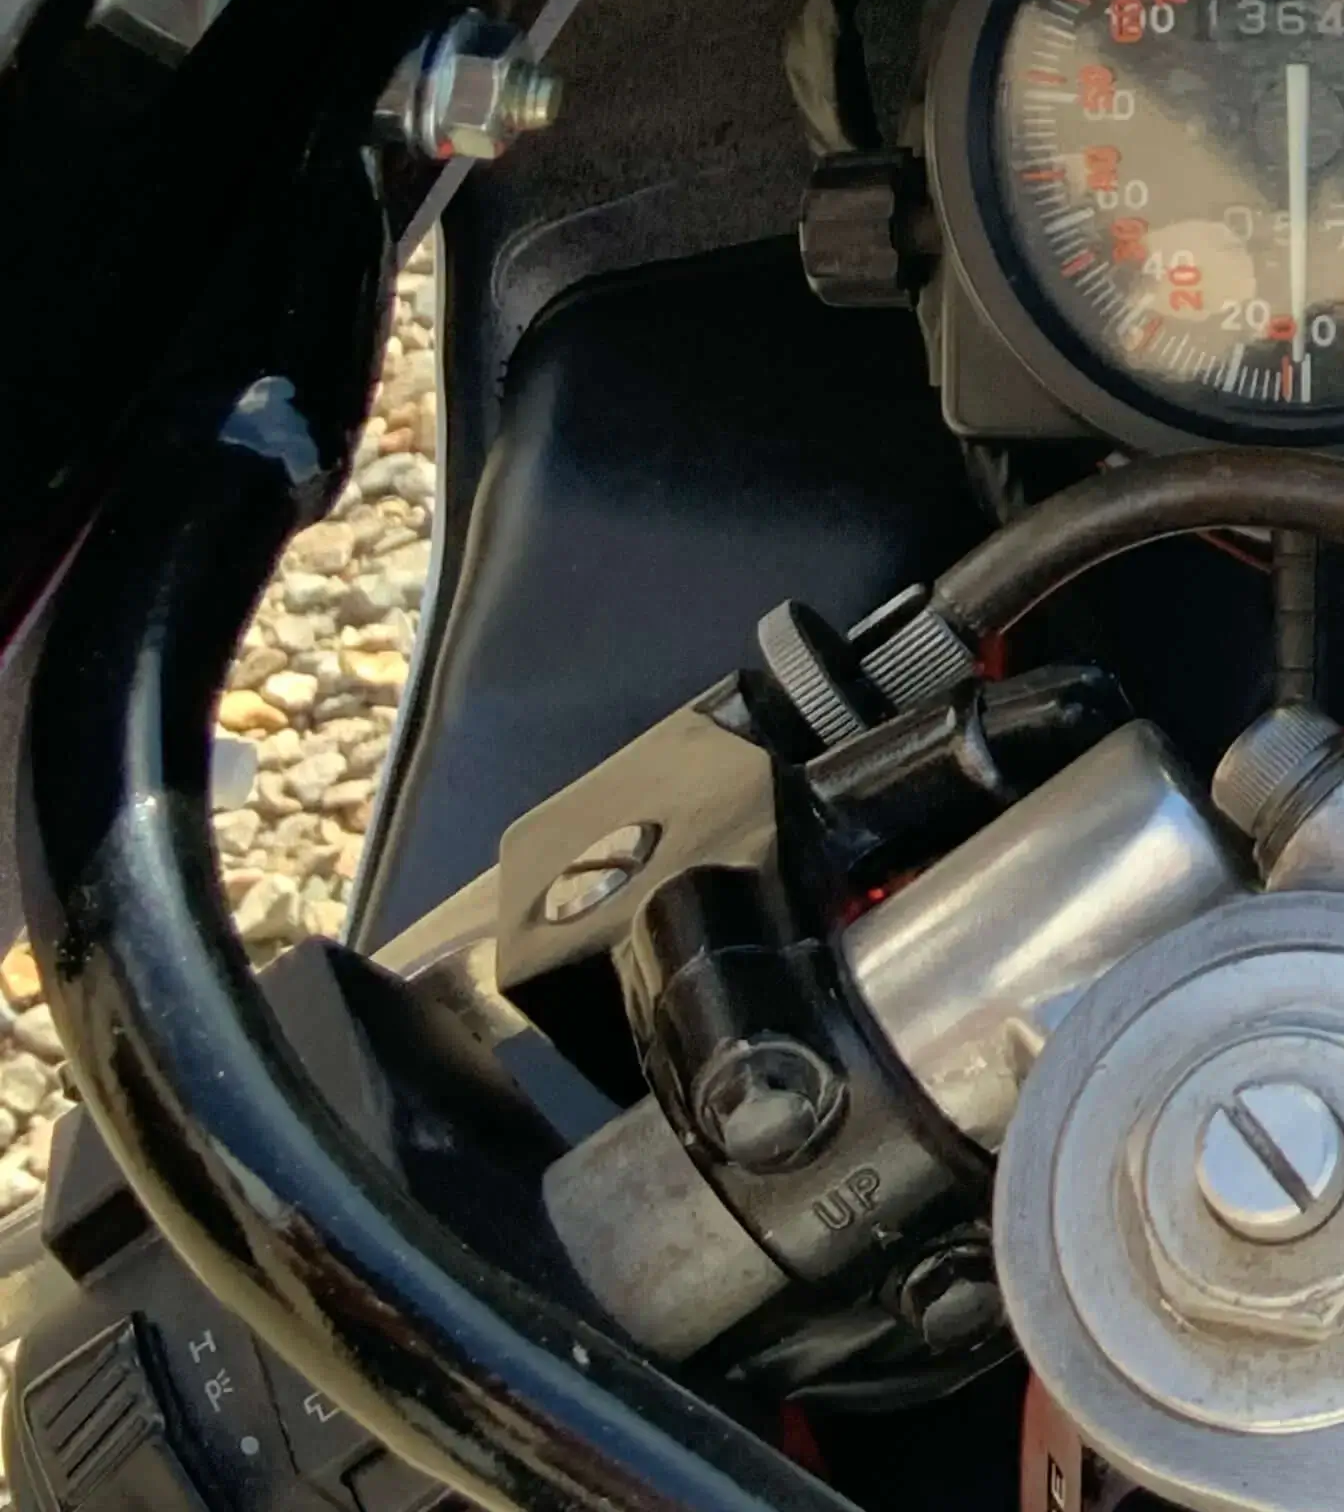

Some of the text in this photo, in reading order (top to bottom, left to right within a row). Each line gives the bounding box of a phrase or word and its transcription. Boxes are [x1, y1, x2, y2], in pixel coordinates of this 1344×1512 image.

[1168, 264, 1203, 311] 20
[1221, 298, 1270, 332] 20
[1311, 314, 1337, 348] 0
[812, 1167, 881, 1231] UP
